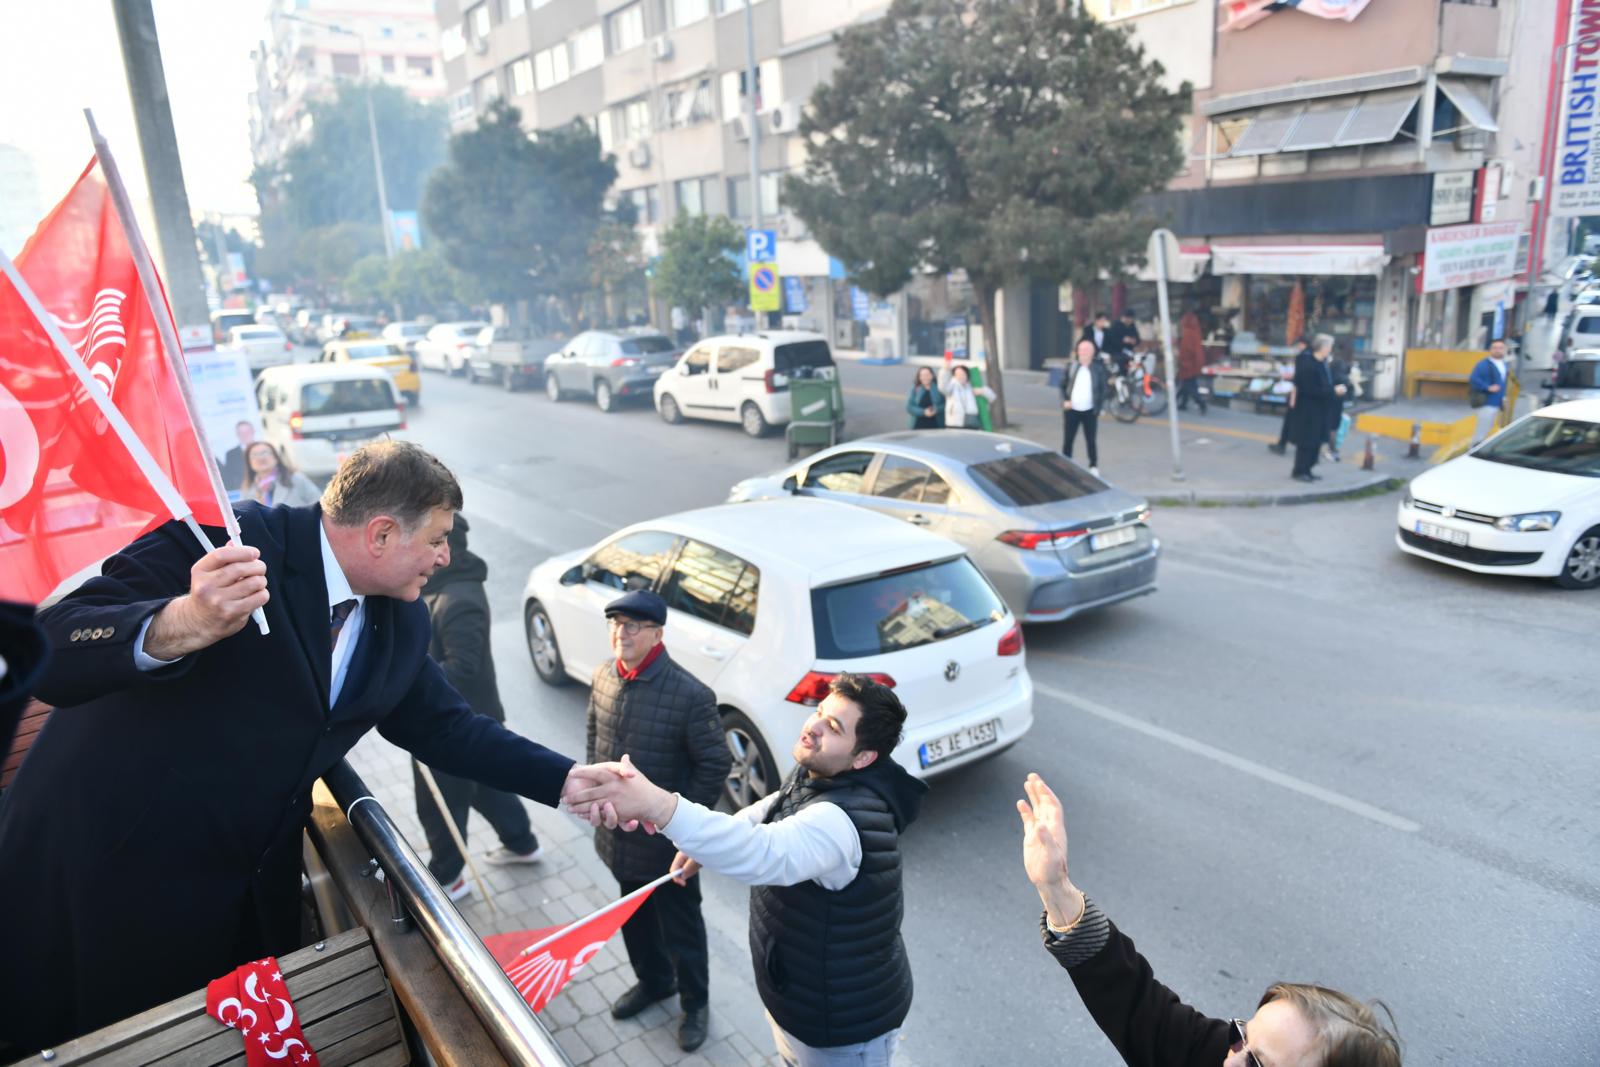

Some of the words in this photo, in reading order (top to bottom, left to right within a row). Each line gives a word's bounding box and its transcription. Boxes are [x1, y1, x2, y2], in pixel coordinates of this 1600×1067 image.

[750, 232, 768, 259] P
[927, 740, 943, 760] 35
[967, 721, 993, 746] 1453
